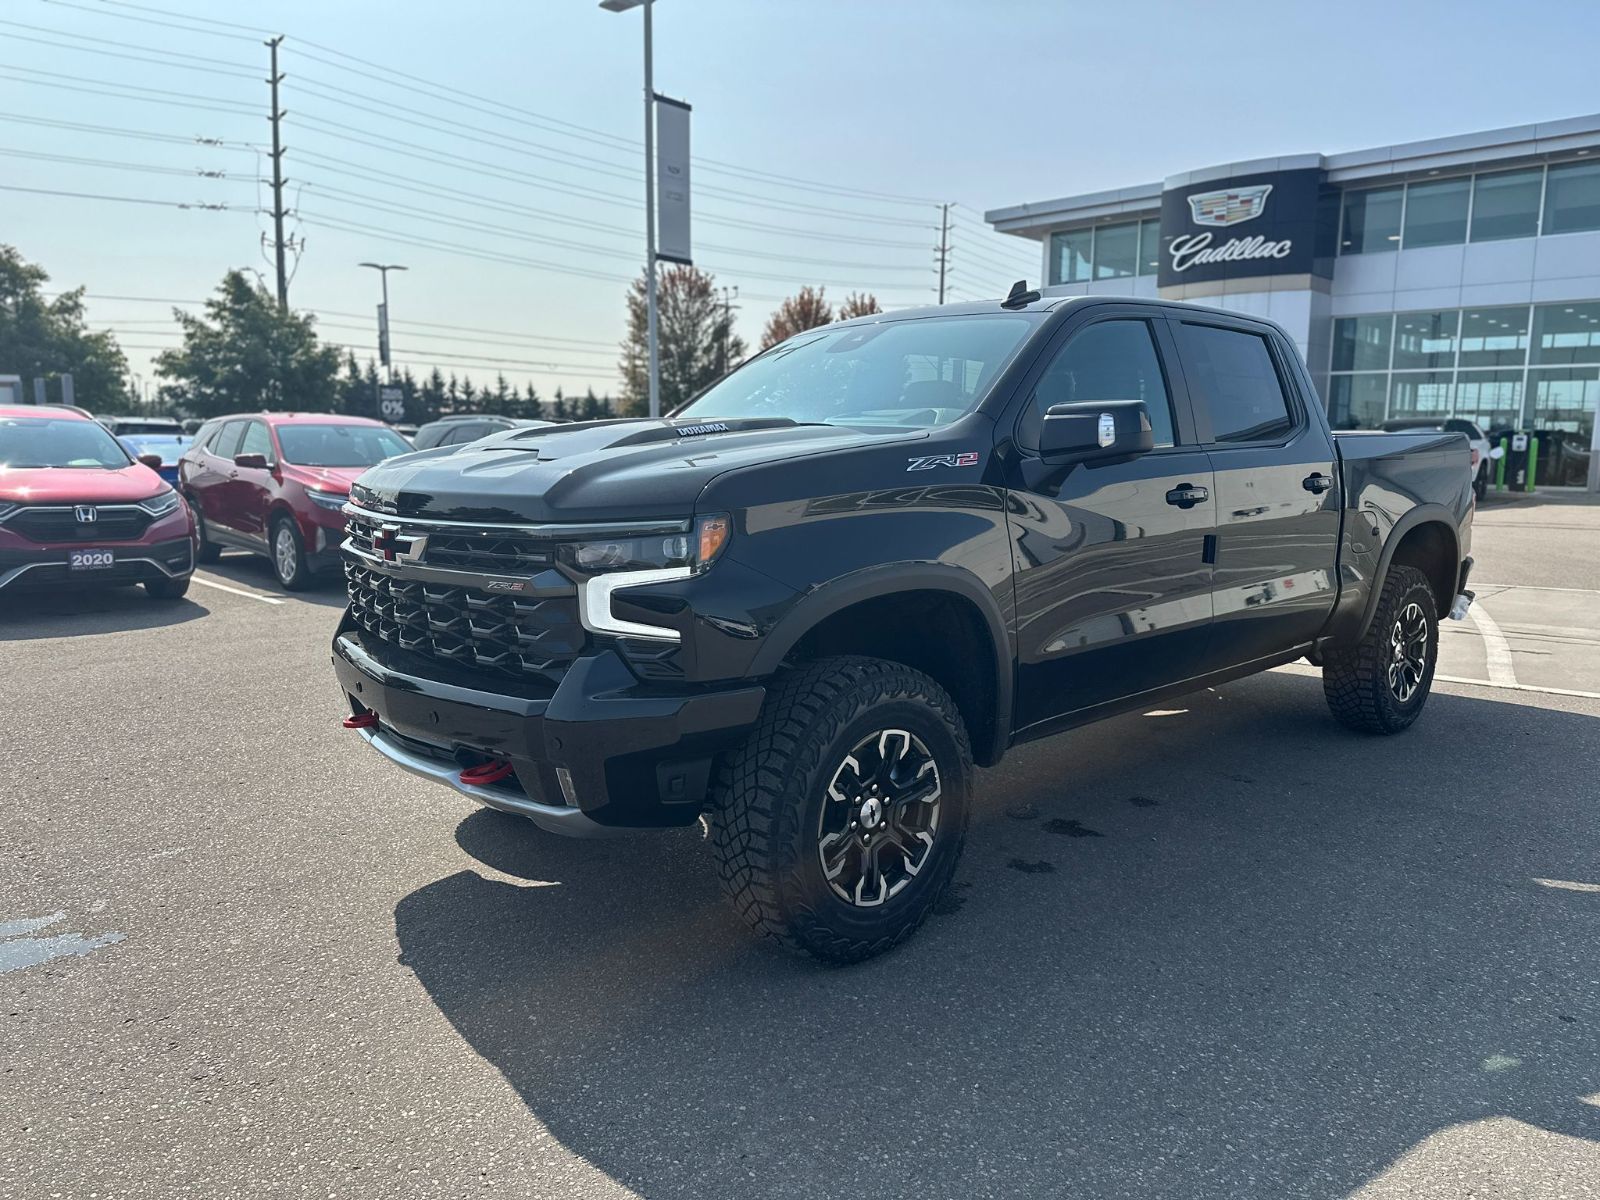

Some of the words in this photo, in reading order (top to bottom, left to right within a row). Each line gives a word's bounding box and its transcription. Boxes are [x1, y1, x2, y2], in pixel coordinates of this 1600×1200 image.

[1169, 232, 1292, 272] Cadillac
[381, 400, 405, 415] 0%
[677, 423, 729, 436] DURAMAX
[906, 452, 978, 472] ZR2
[72, 553, 113, 566] 2020
[487, 581, 525, 591] ZR2
